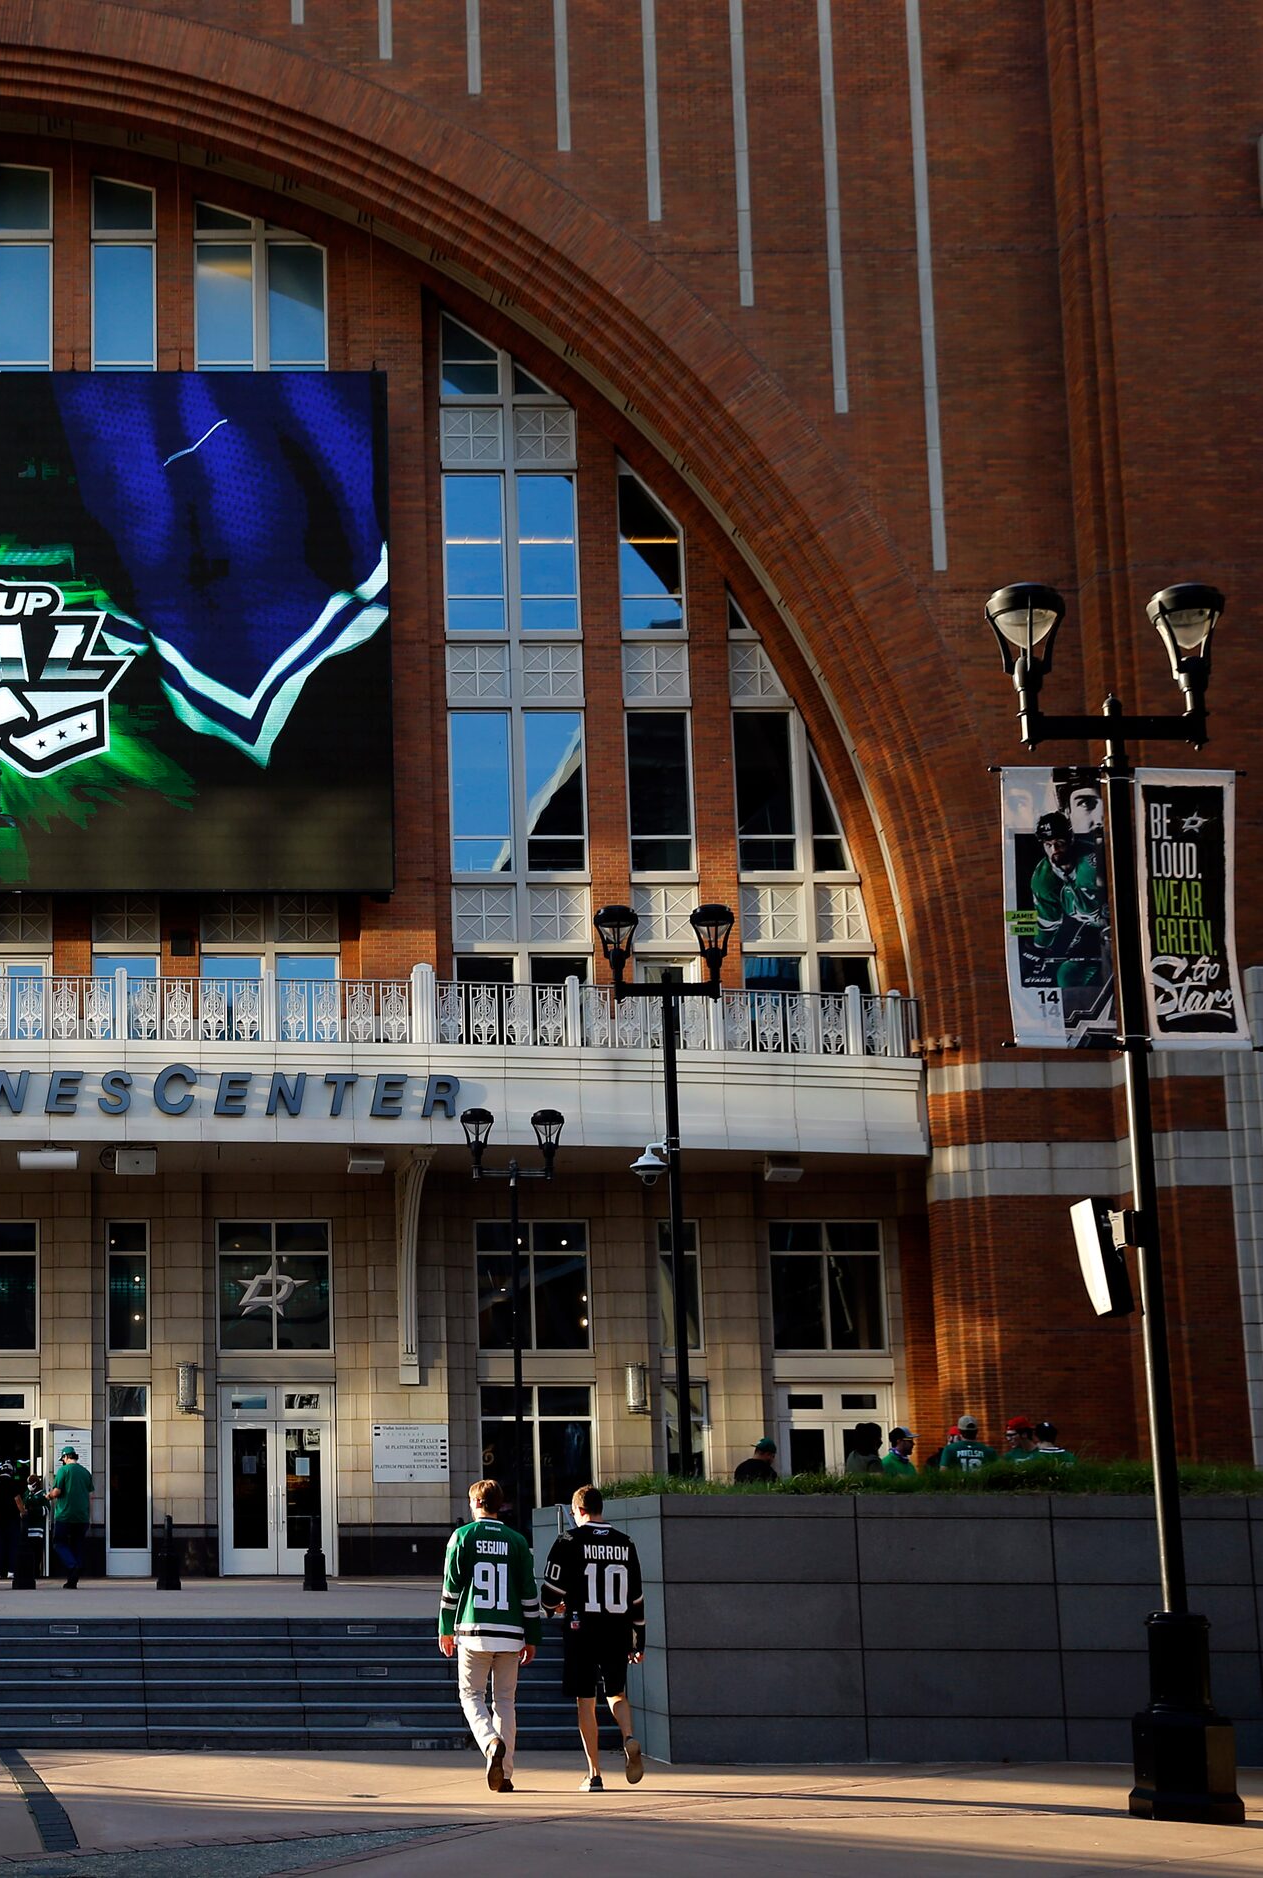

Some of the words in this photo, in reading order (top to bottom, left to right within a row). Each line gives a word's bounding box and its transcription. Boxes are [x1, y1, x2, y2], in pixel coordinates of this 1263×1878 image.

[1149, 803, 1173, 840] BE
[1151, 841, 1203, 880] LOUD.
[1152, 879, 1204, 917] WEAR
[1155, 917, 1218, 956] GREEN.
[1150, 955, 1234, 1016] Stars
[1191, 955, 1221, 986] Go
[1037, 990, 1060, 1005] 14
[475, 1540, 508, 1556] SEGUIN
[583, 1544, 629, 1562] MORROW
[473, 1561, 510, 1611] 91
[545, 1561, 562, 1580] 10
[584, 1562, 629, 1614] 10
